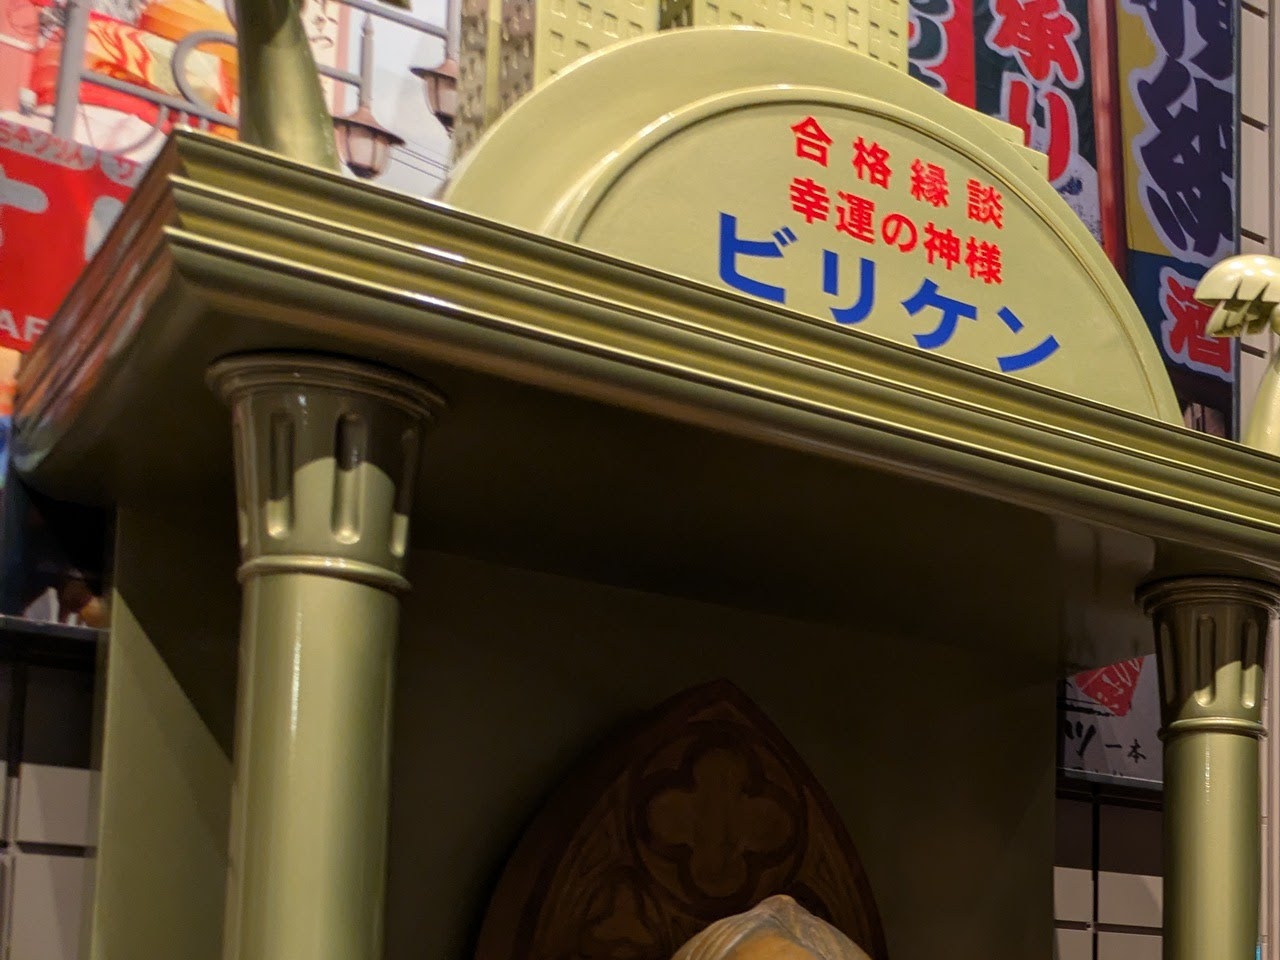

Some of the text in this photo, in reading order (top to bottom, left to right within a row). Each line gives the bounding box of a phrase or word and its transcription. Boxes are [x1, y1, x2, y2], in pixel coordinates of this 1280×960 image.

[790, 115, 1005, 230] 合格縁談
[789, 176, 1004, 286] 幸運の神様
[718, 210, 1062, 374] ビリケン
